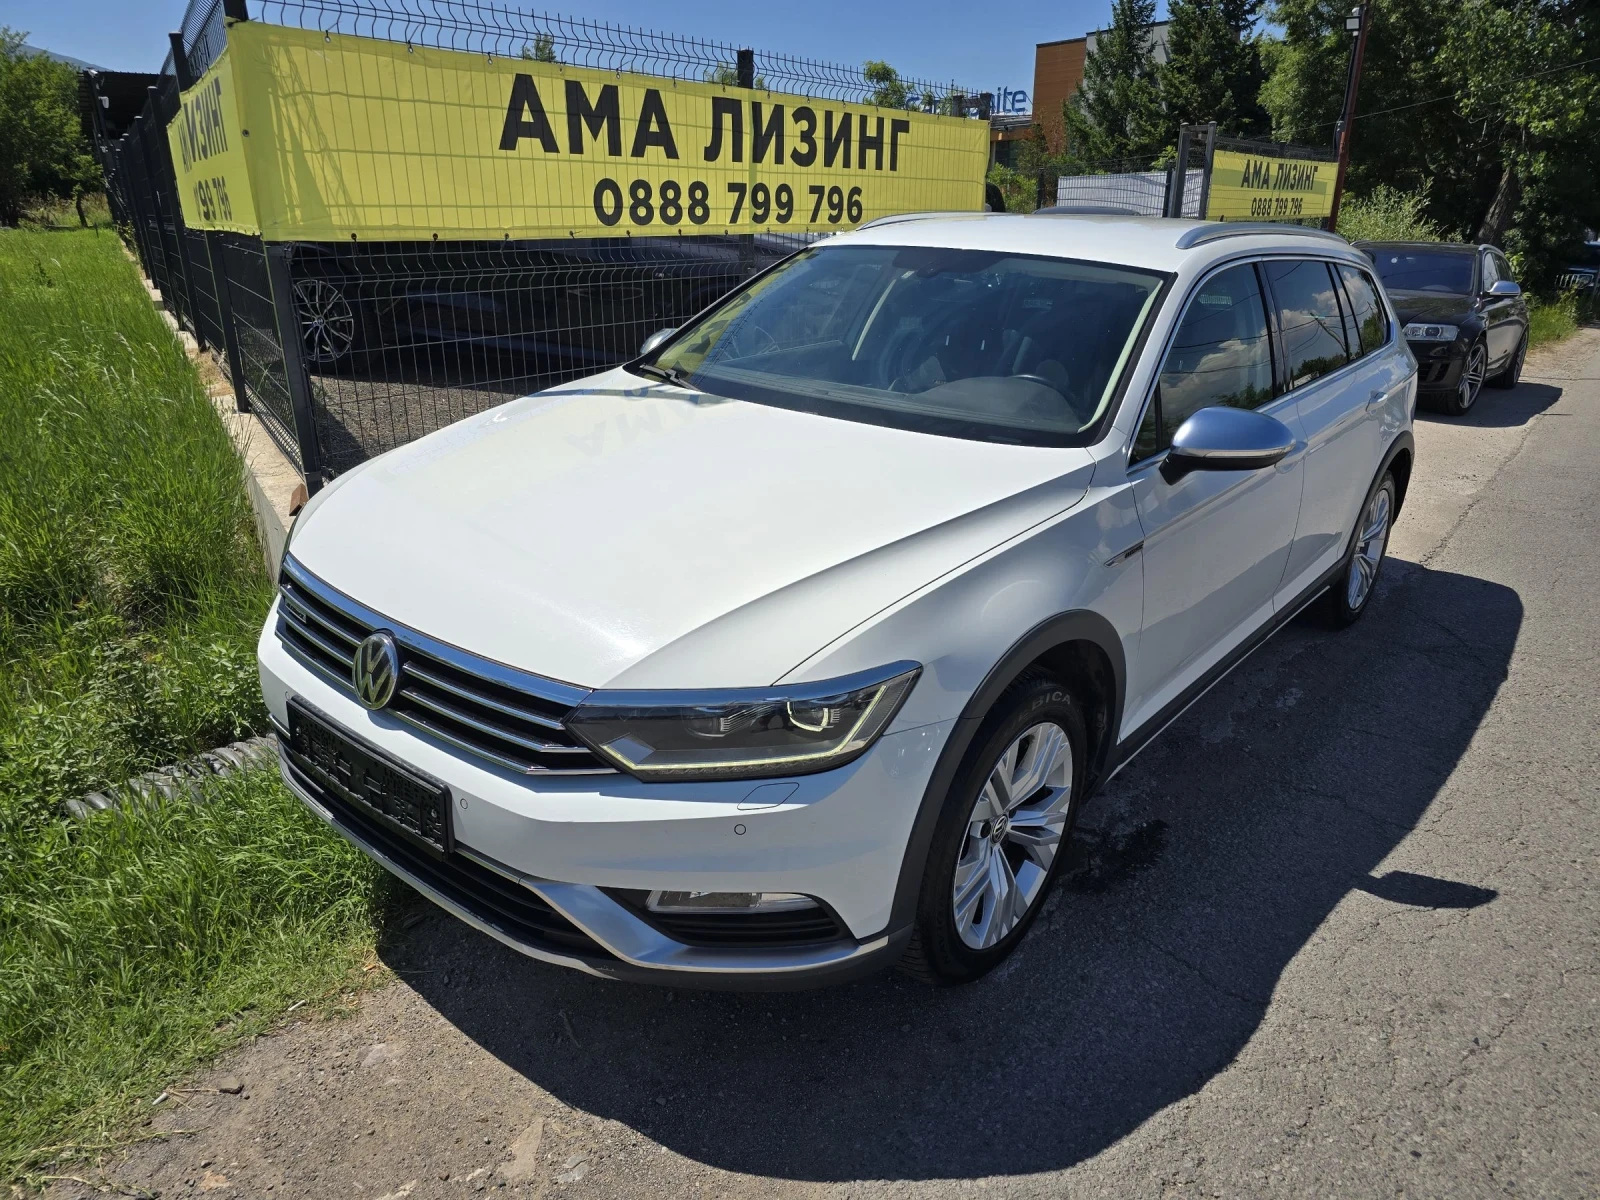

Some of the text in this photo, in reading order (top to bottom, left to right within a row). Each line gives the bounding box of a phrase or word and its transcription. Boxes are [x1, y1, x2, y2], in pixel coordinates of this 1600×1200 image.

[500, 74, 909, 171] АМА ЛИЗИНГ
[212, 175, 232, 221] 796
[1241, 160, 1318, 190] АМА ЛИЗИНГ
[593, 177, 864, 227] 0888 799 796
[1251, 197, 1303, 216] 0888 799 796
